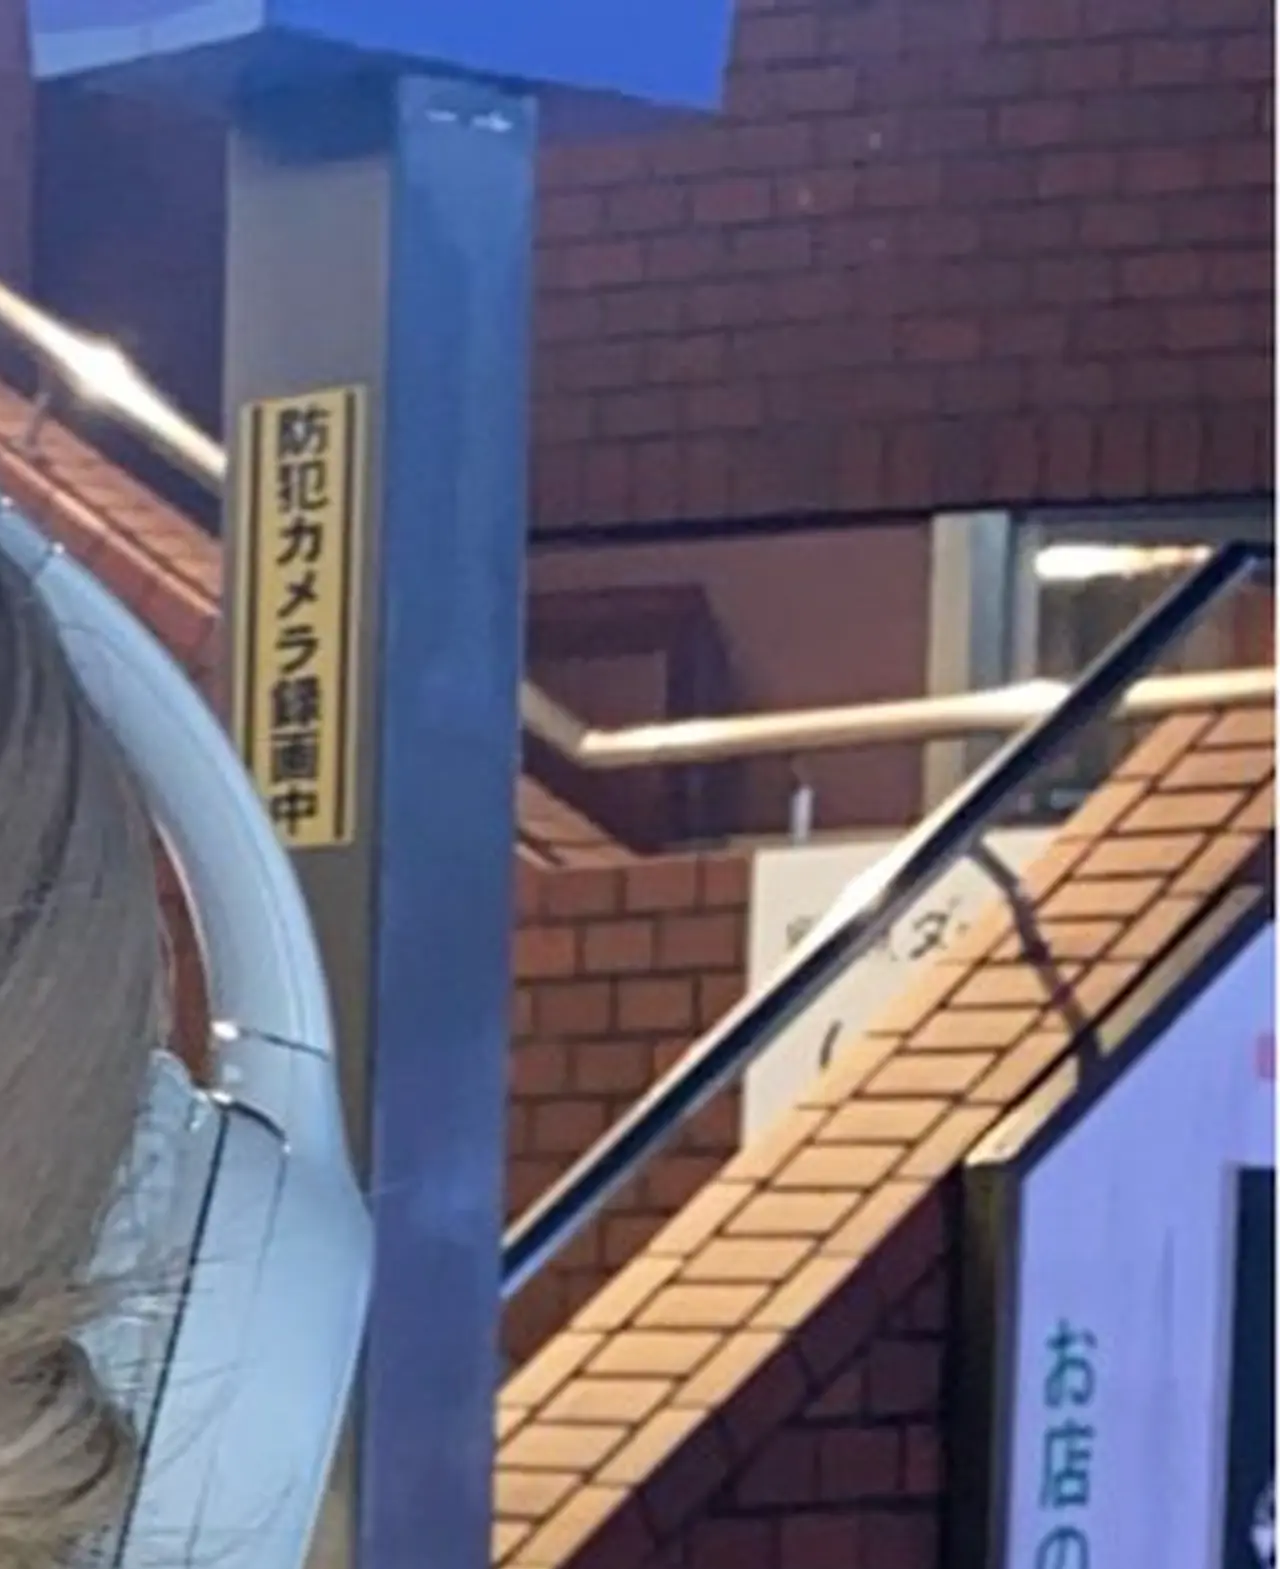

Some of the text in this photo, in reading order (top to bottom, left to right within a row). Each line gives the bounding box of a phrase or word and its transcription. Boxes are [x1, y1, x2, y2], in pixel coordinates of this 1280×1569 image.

[268, 408, 330, 836] 防犯カメラ録画中
